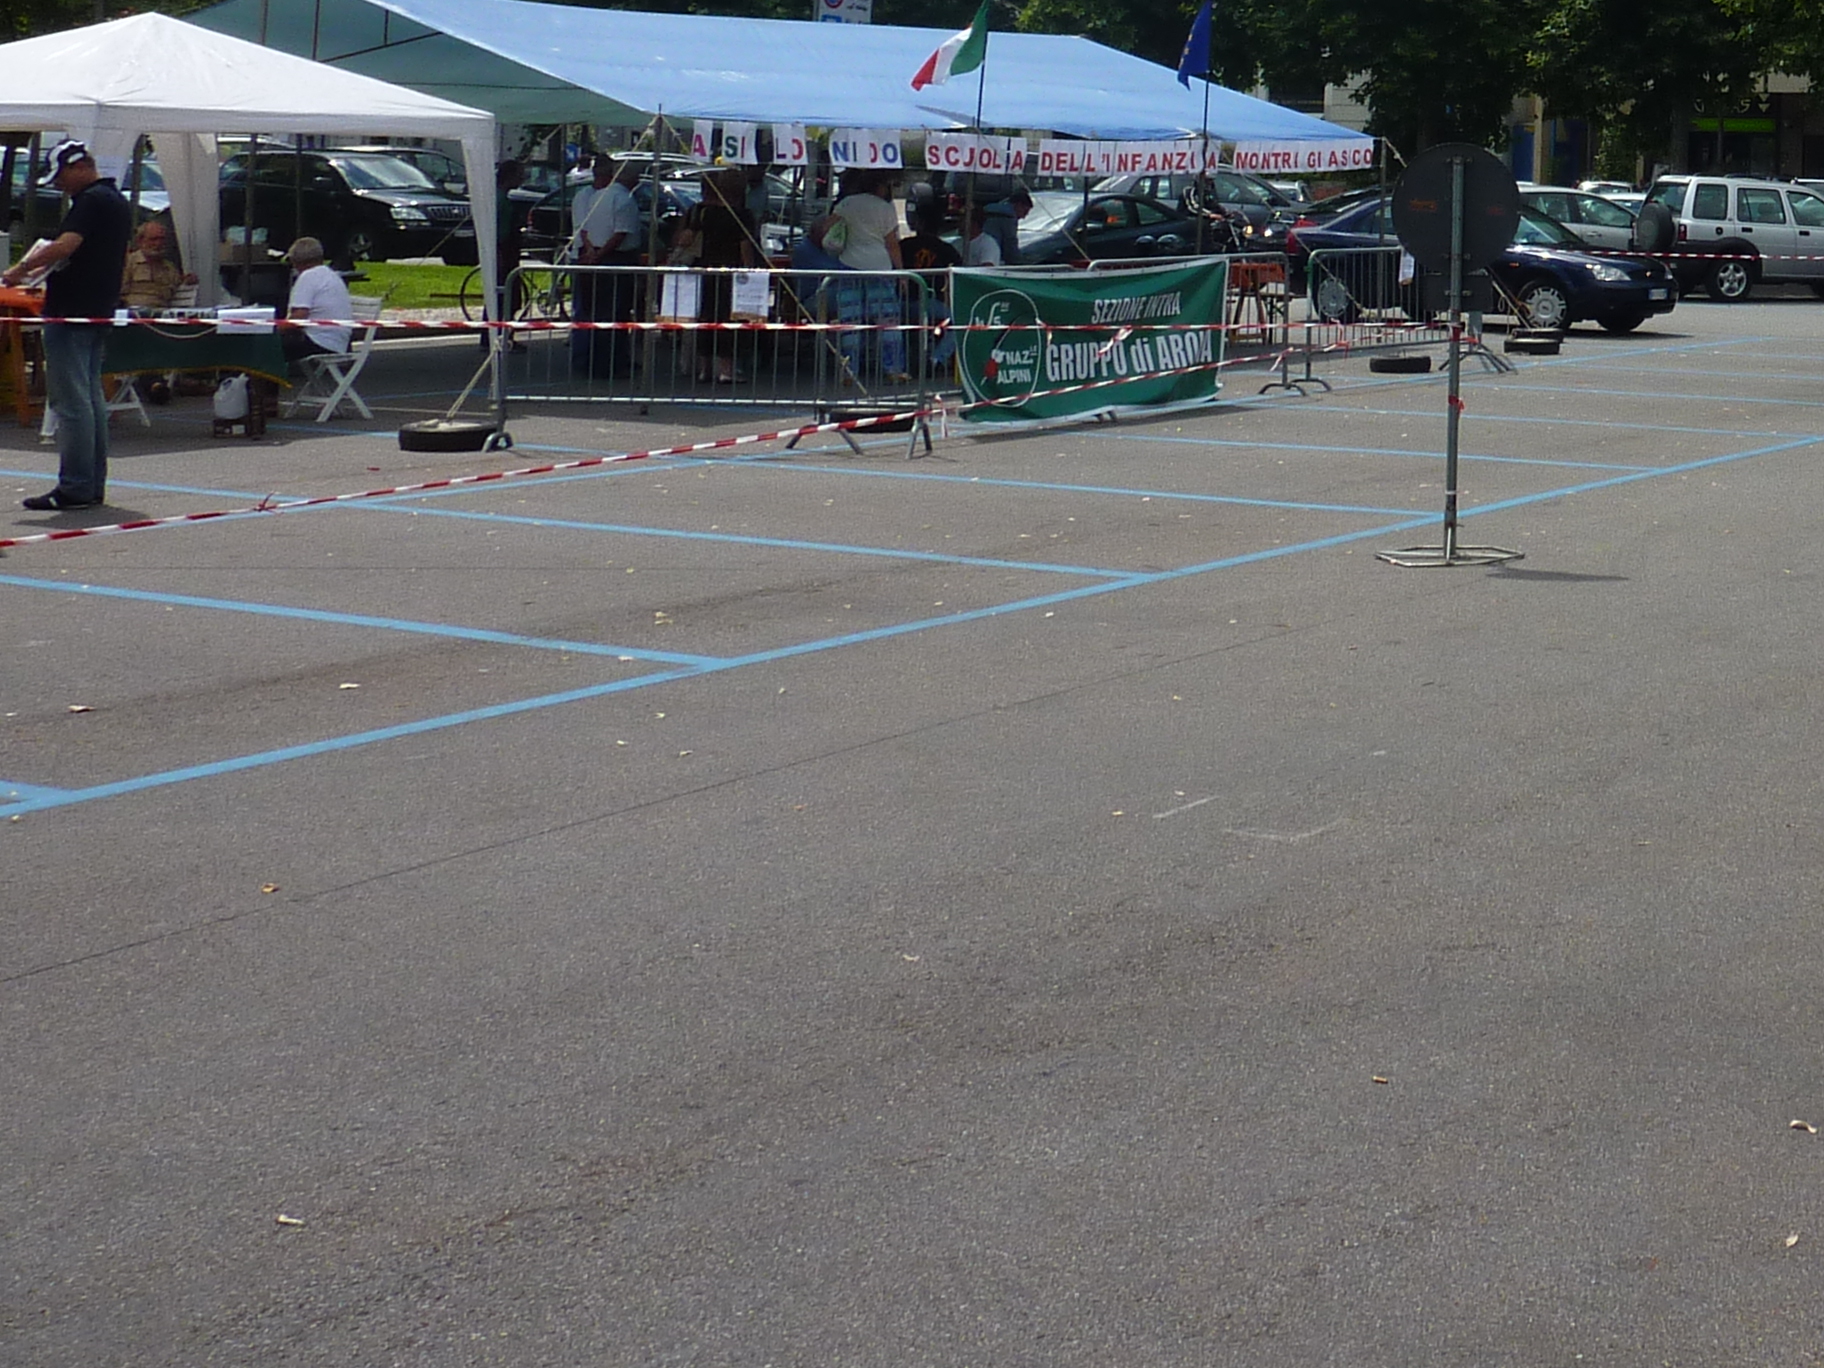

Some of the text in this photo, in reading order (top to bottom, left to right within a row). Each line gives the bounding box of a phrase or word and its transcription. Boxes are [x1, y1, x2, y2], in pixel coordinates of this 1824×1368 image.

[1091, 291, 1181, 324] SEZIONE INTRA
[997, 368, 1031, 384] ALPINI
[1046, 340, 1127, 382] GRUPPO
[1131, 337, 1155, 372] di
